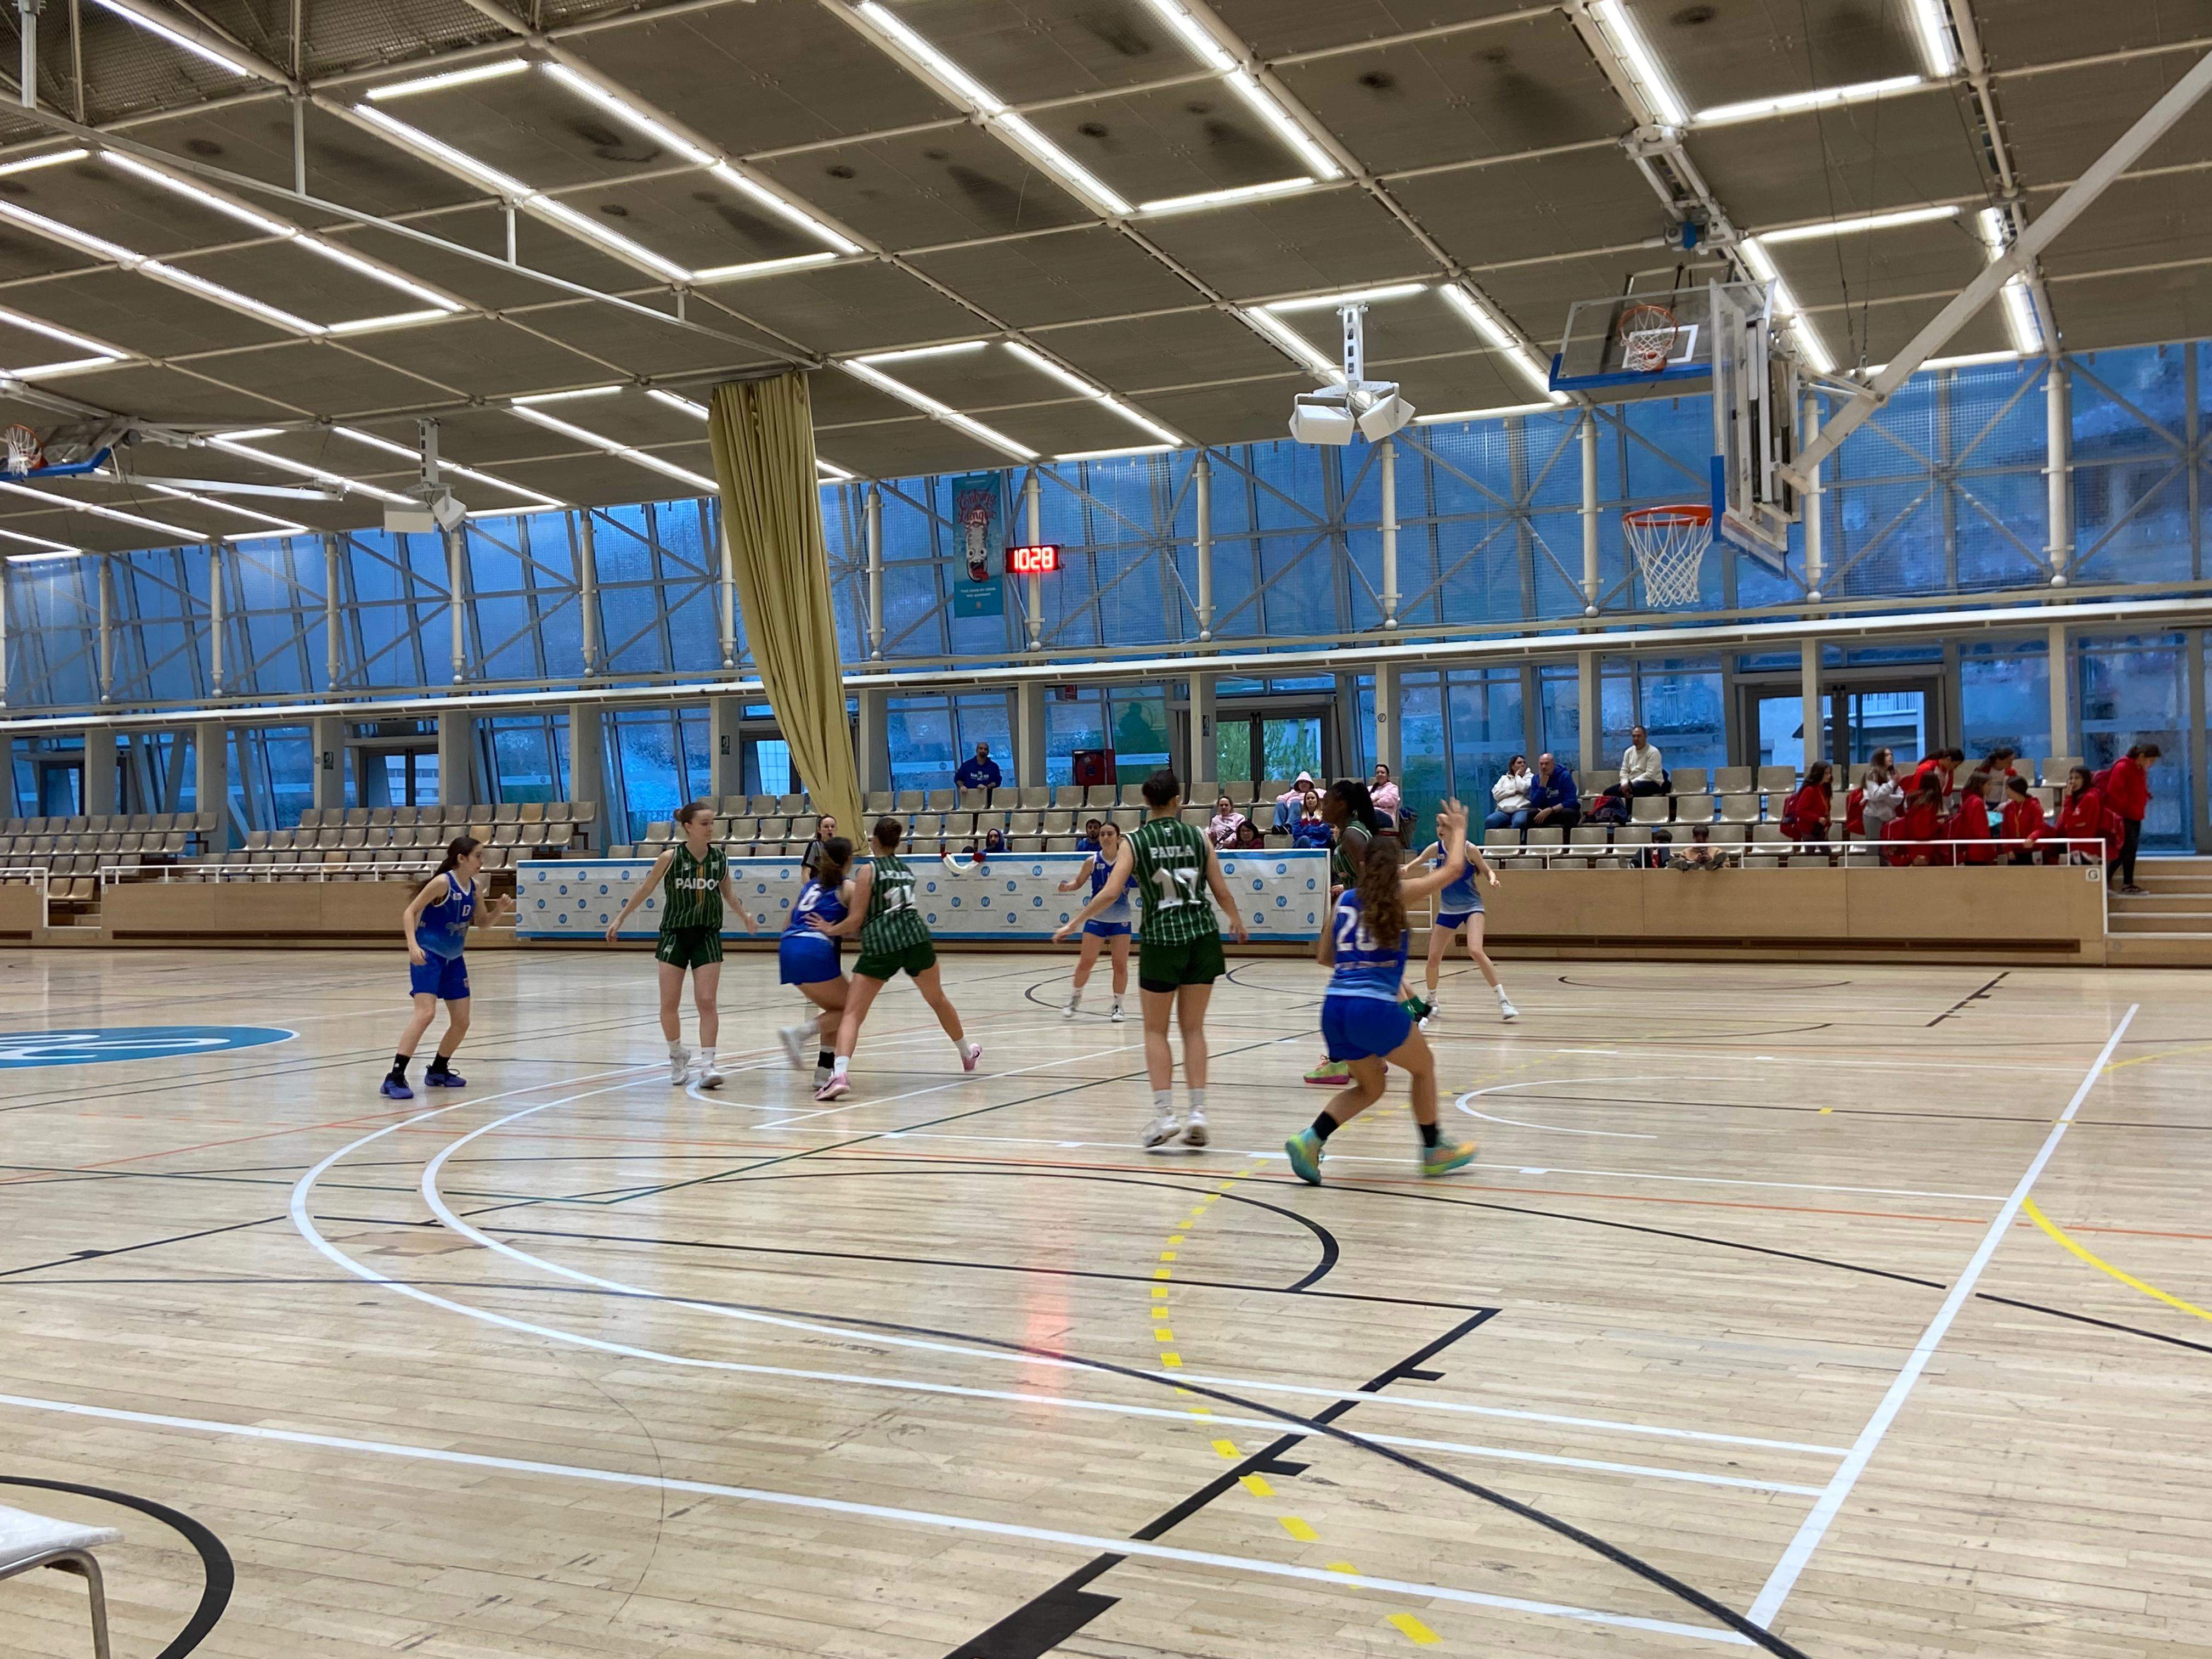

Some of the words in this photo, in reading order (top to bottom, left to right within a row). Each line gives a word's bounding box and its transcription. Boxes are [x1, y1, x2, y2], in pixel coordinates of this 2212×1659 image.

[1014, 546, 1053, 570] 1028
[1149, 845, 1195, 859] PAULA
[798, 883, 822, 911] 6
[1151, 867, 1201, 910] 17
